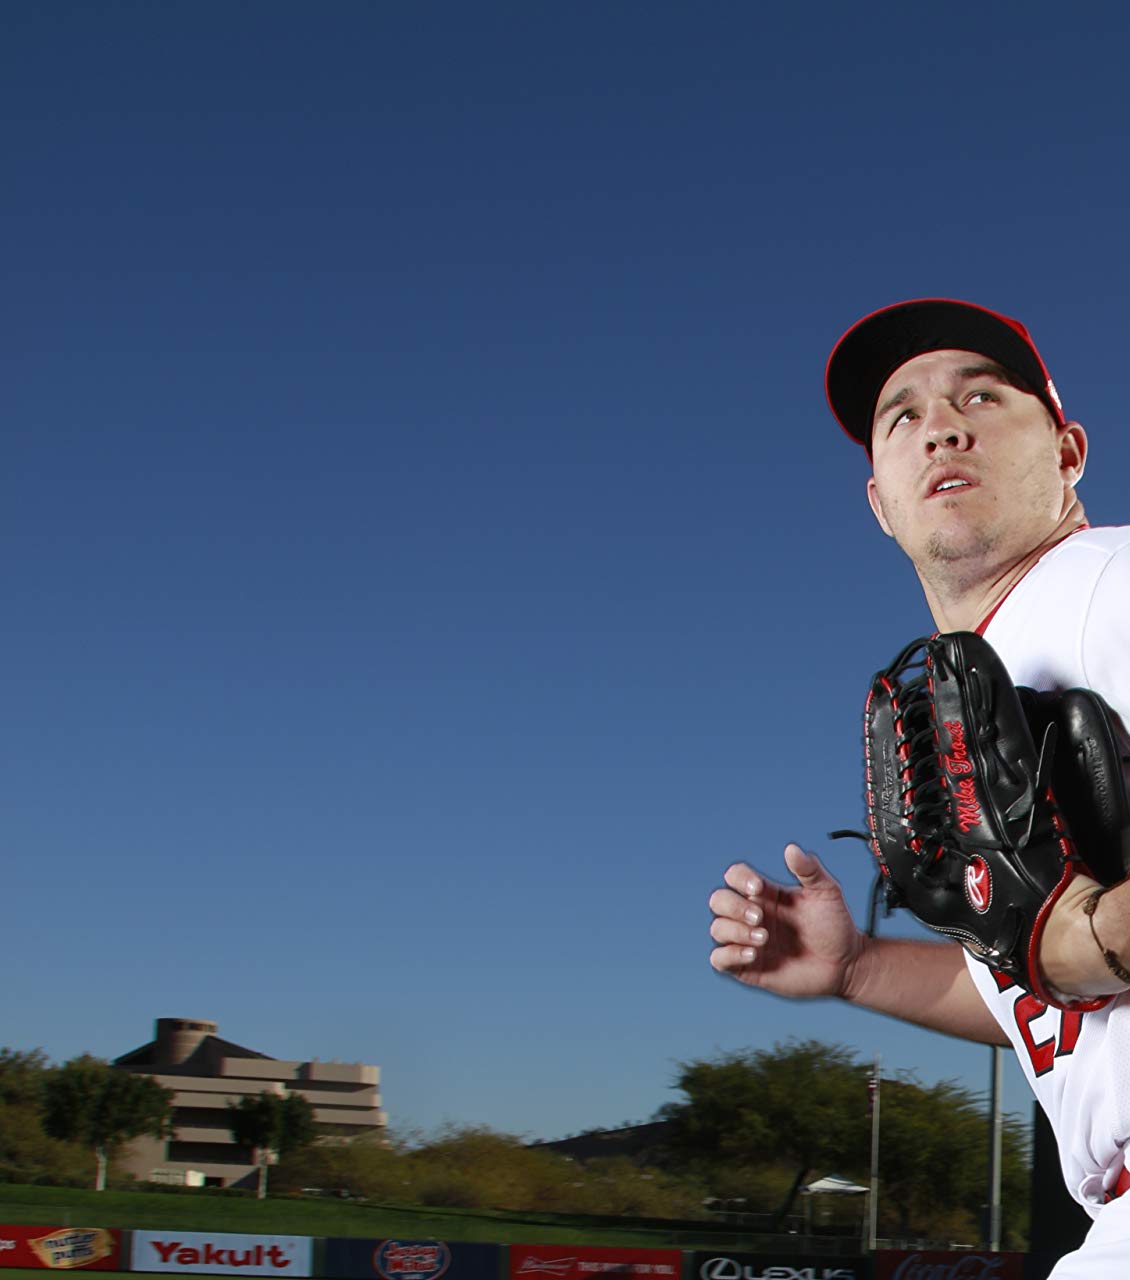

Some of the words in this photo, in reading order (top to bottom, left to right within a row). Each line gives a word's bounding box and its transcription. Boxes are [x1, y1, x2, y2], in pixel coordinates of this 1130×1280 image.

[942, 720, 973, 775] Trout
[952, 776, 981, 833] Mike
[149, 1240, 292, 1268] Yakult
